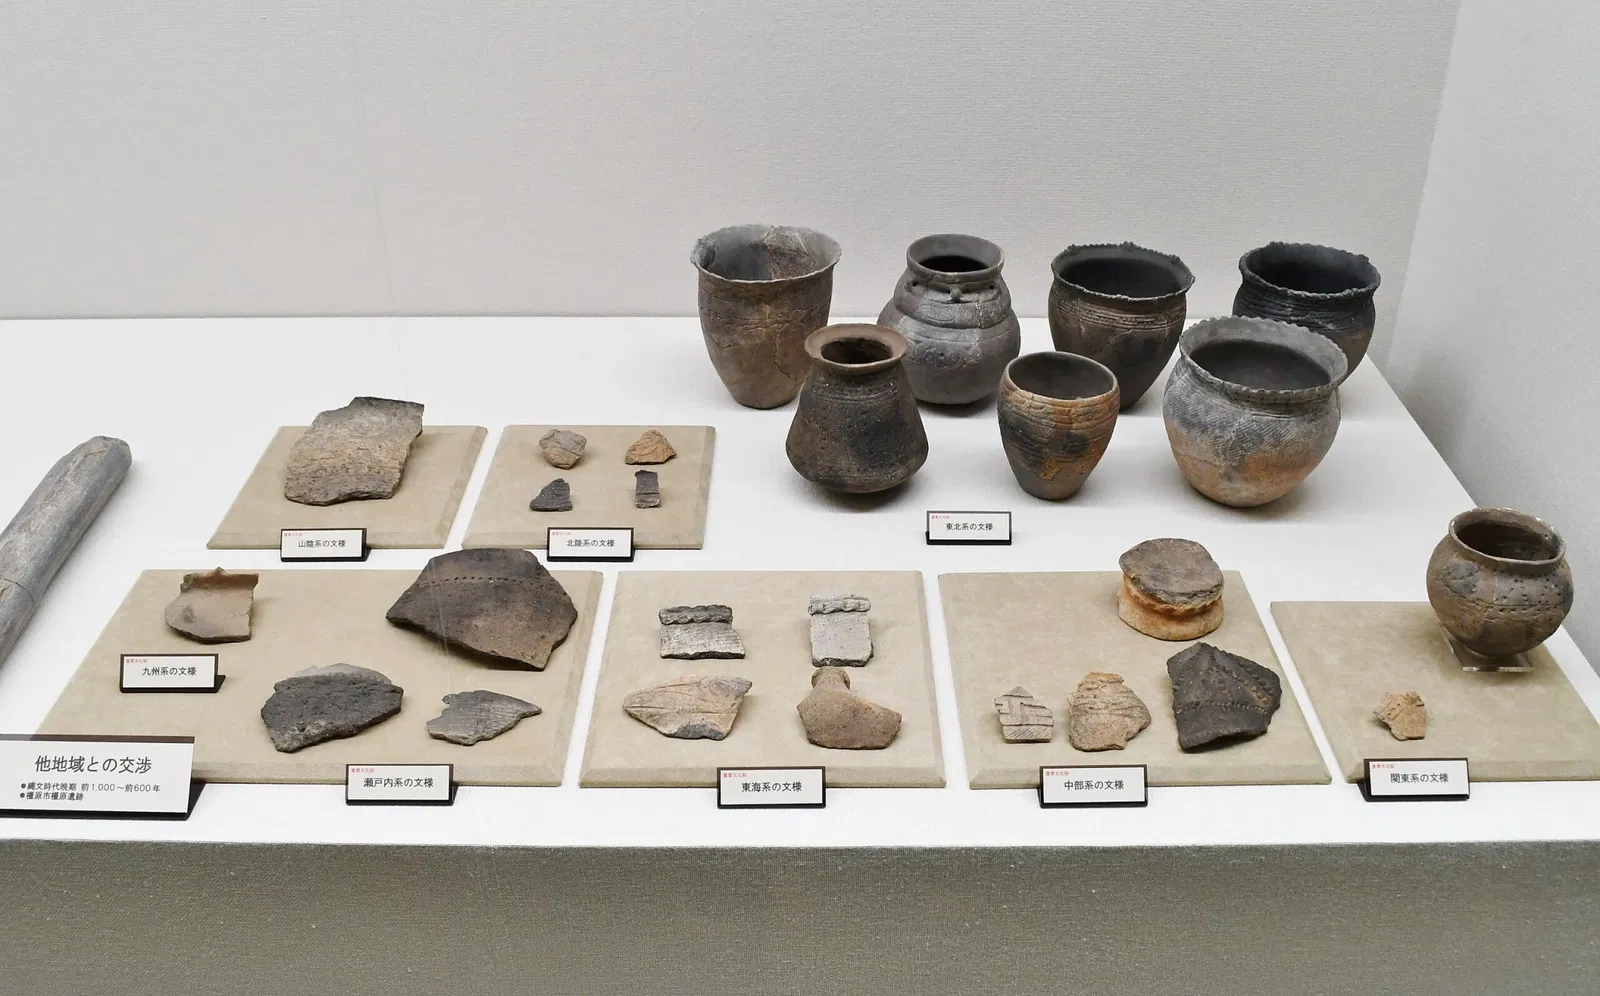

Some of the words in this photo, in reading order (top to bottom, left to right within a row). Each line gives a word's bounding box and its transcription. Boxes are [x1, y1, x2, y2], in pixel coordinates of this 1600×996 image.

[945, 522, 993, 531] 東北系の文様
[298, 539, 346, 548] 山陰系の文様
[566, 538, 615, 547] 北陸系の文様
[142, 666, 197, 676] 九州系の文様
[35, 755, 153, 774] 他地域との交渉
[363, 777, 434, 788] 瀬戸内系の文様
[1390, 772, 1449, 783] 関東系の文様
[741, 781, 802, 792] 東海系の文様
[1064, 779, 1124, 790] 中部系の文様
